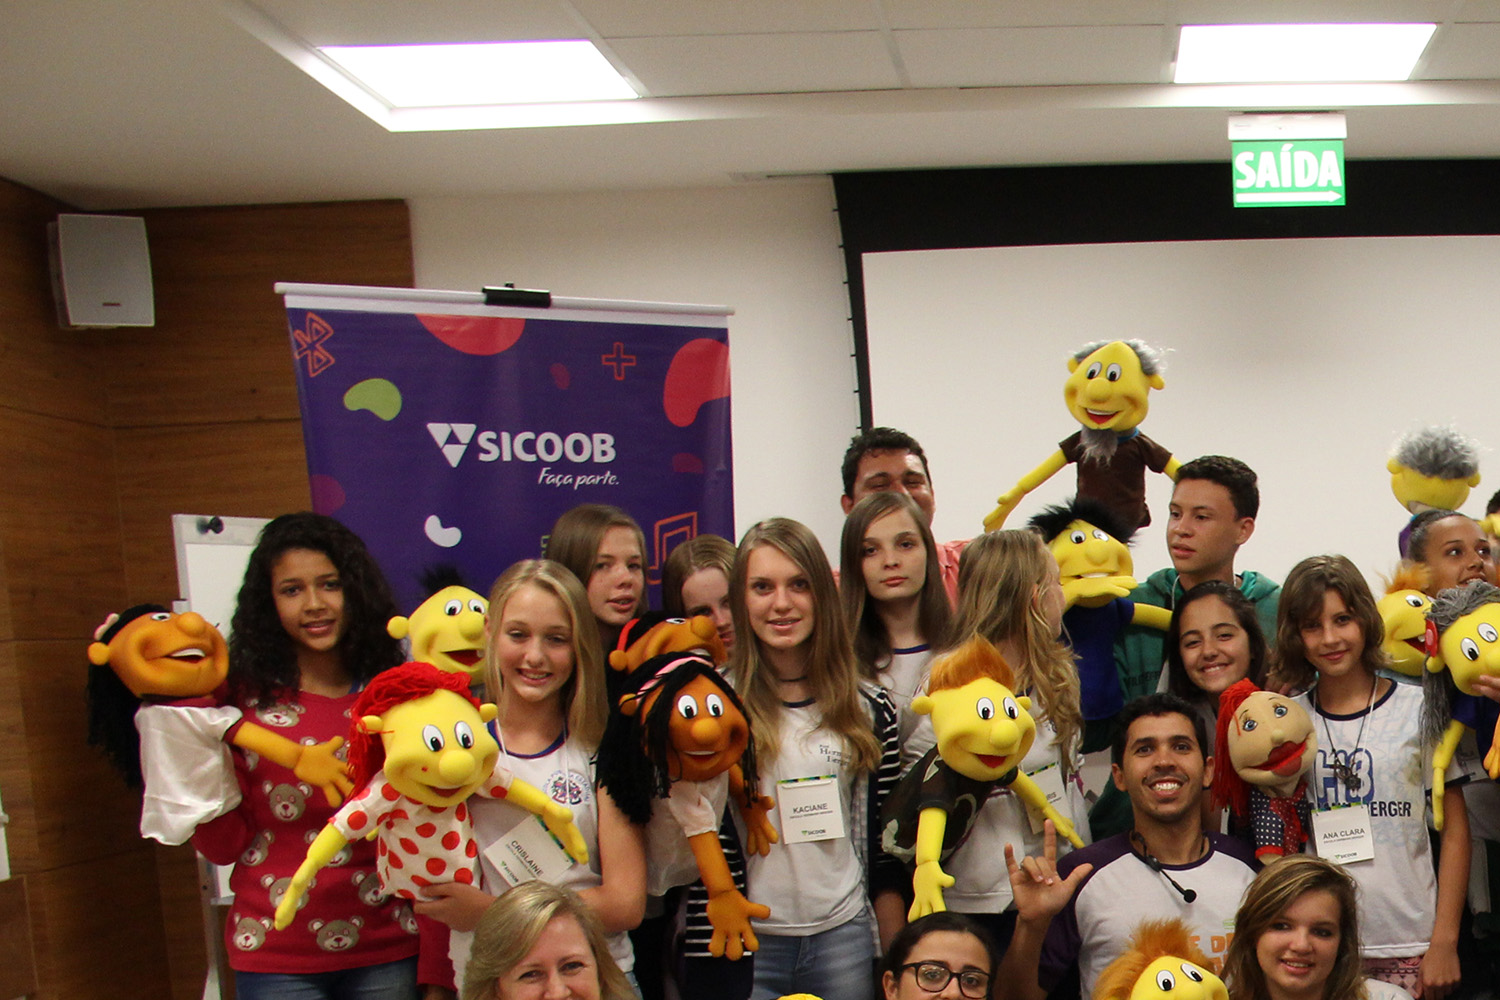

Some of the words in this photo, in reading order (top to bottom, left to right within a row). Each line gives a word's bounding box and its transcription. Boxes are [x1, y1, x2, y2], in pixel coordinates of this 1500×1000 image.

[1235, 143, 1342, 189] SAÍDA
[477, 431, 616, 463] SICOOB
[538, 467, 573, 487] Faça
[574, 470, 620, 490] parte.
[793, 803, 828, 814] KACIANE
[1369, 800, 1412, 817] ERGER
[1323, 831, 1339, 840] ANA
[1340, 828, 1365, 837] CLARA
[511, 840, 544, 876] CRISLAINE
